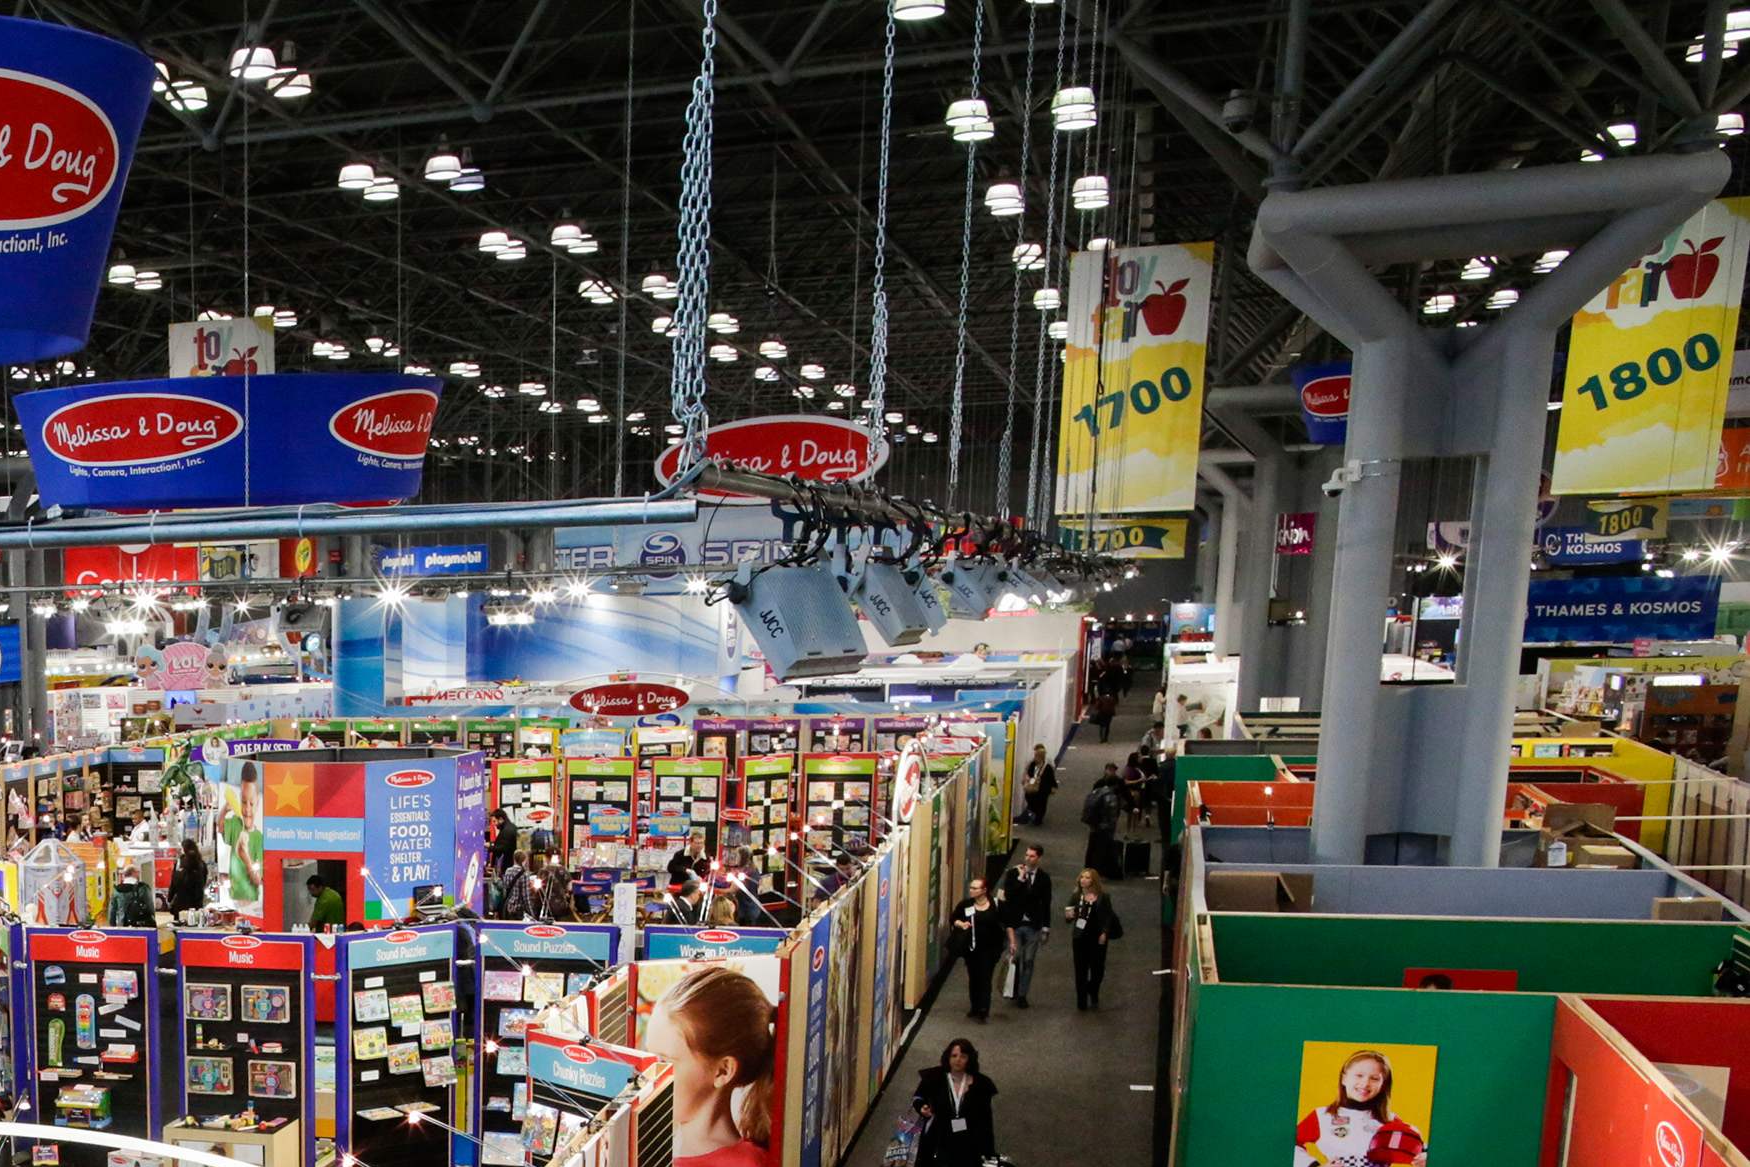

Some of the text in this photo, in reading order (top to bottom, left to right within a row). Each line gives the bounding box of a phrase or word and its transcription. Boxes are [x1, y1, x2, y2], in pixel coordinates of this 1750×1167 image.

[24, 122, 97, 203] Doug
[47, 231, 68, 248] Inc.
[1577, 333, 1721, 412] 1800
[1073, 366, 1192, 438] 1700
[53, 412, 218, 452] Melissa & Doug
[352, 408, 413, 440] Melissa
[69, 464, 91, 478] Lights,
[92, 465, 127, 478] Camera,
[185, 457, 206, 470] Inc.
[781, 439, 857, 482] & Doug
[1600, 506, 1643, 536] 1800
[1566, 542, 1622, 555] KOSMOS
[425, 550, 482, 568] playmobil
[646, 554, 680, 565] SPIN
[869, 593, 891, 618] JJCC
[1535, 601, 1702, 617] THAMES & KOSMOS
[760, 609, 784, 639] JJCC
[433, 688, 504, 701] MECCANO
[582, 692, 633, 708] Melissa
[647, 692, 678, 710] Doug
[390, 795, 431, 810] LIFE'S
[390, 811, 431, 824] ESSENTIALS:
[266, 828, 361, 843] Refresh Your Imagination!
[389, 825, 432, 839] FOOD,
[389, 838, 431, 851] WATER
[389, 853, 422, 865] SHELTER
[392, 866, 430, 882] & PLAY!
[76, 945, 100, 959] Music
[376, 945, 427, 961] Sound Puzzles
[513, 940, 576, 955] Sound Puzzles
[228, 950, 253, 965] Music
[553, 1062, 606, 1089] Chunky Puzzles
